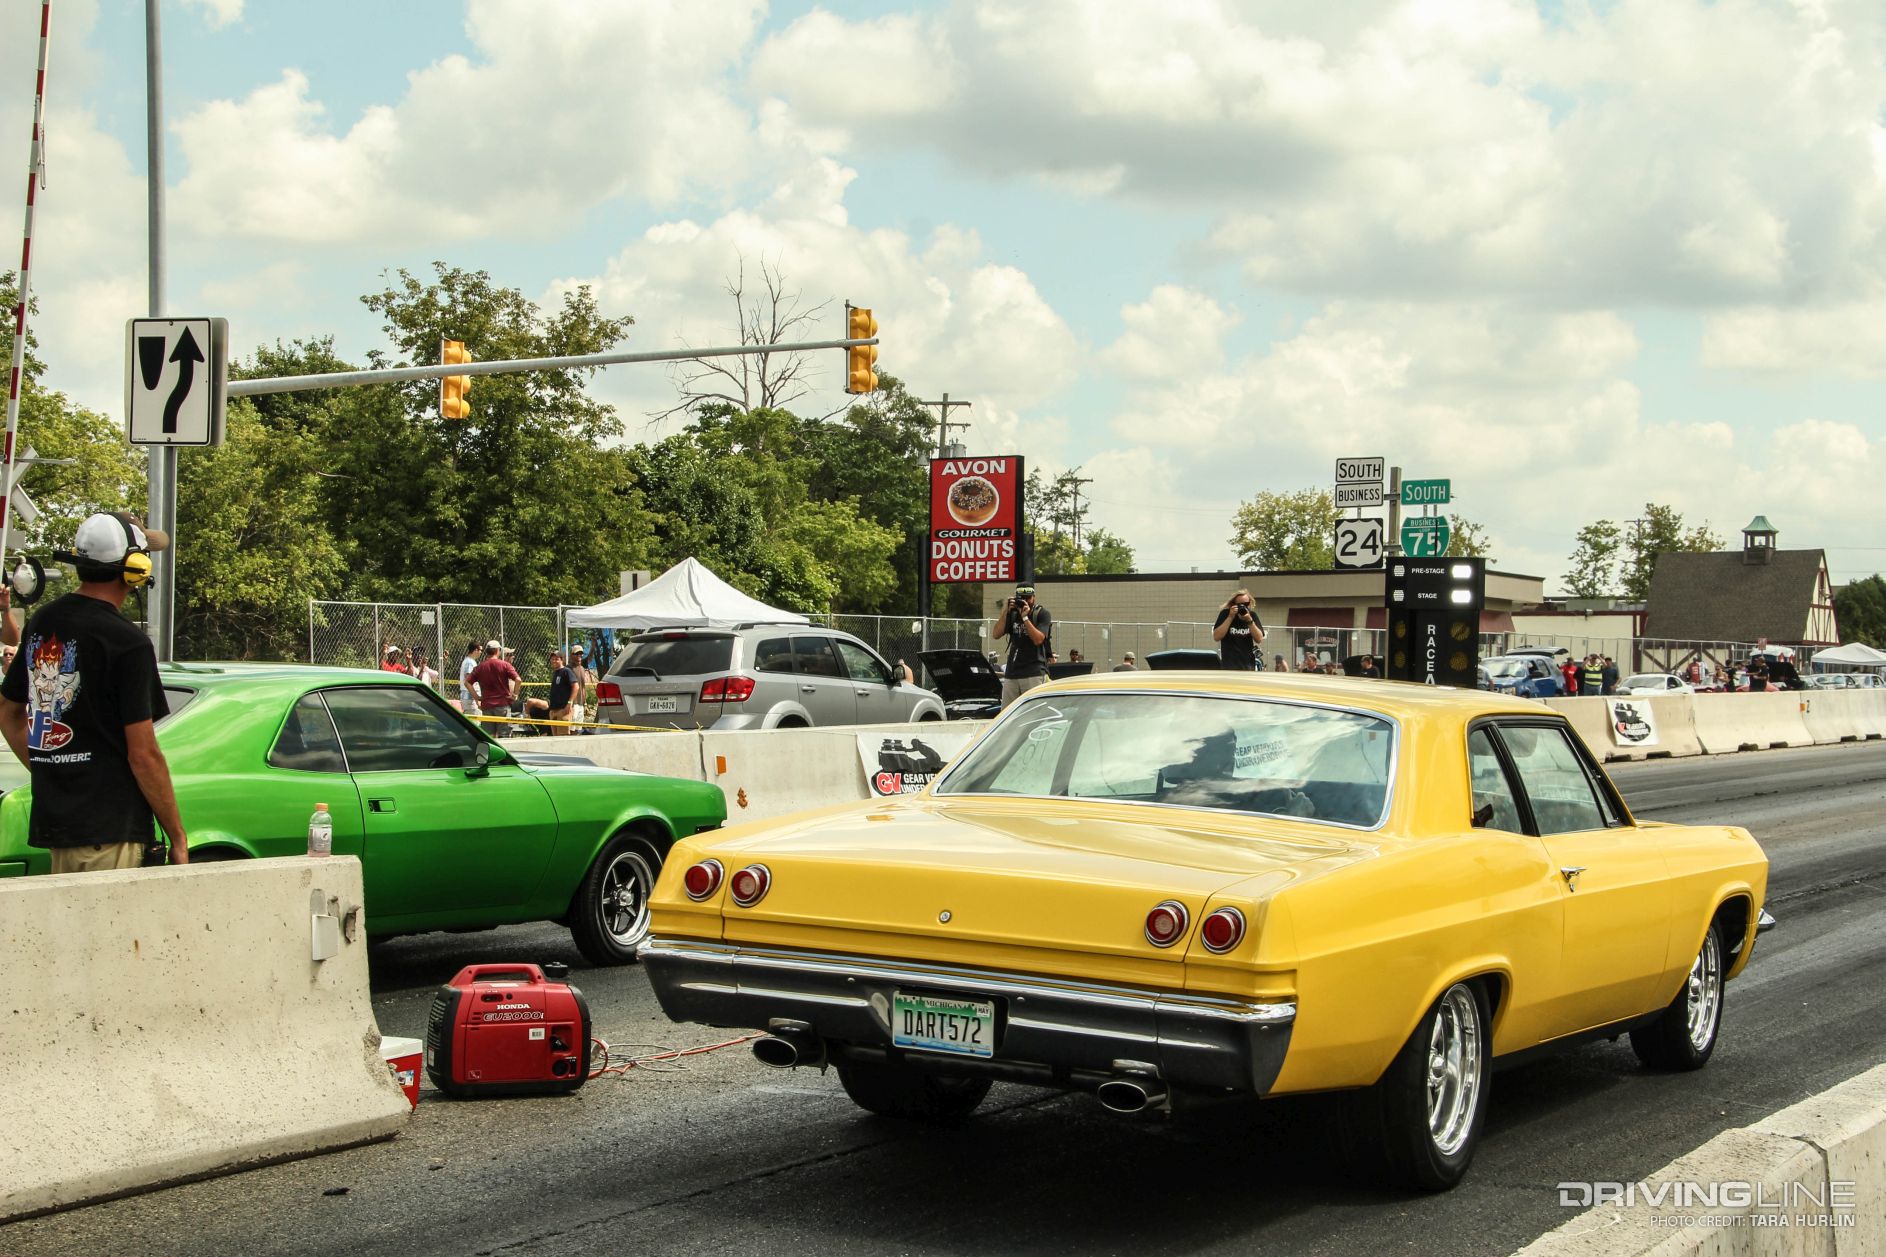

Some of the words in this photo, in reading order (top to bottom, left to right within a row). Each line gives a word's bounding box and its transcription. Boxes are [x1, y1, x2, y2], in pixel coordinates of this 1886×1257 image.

[941, 460, 1006, 475] AVON
[1339, 463, 1381, 479] SOUTH
[1338, 488, 1380, 502] BUSINESS
[1405, 485, 1446, 501] SOUTH
[1410, 519, 1440, 527] BUSINESS
[938, 529, 1008, 538] GOURMET
[932, 539, 1014, 559] DONUTS
[1340, 528, 1379, 557] 24
[1408, 532, 1442, 556] 75
[936, 561, 1009, 580] COFFEE
[877, 772, 901, 794] GV
[903, 773, 925, 784] GEAR
[924, 773, 937, 783] VE
[925, 1000, 962, 1009] MICHIGAN
[904, 1009, 982, 1044] DART572
